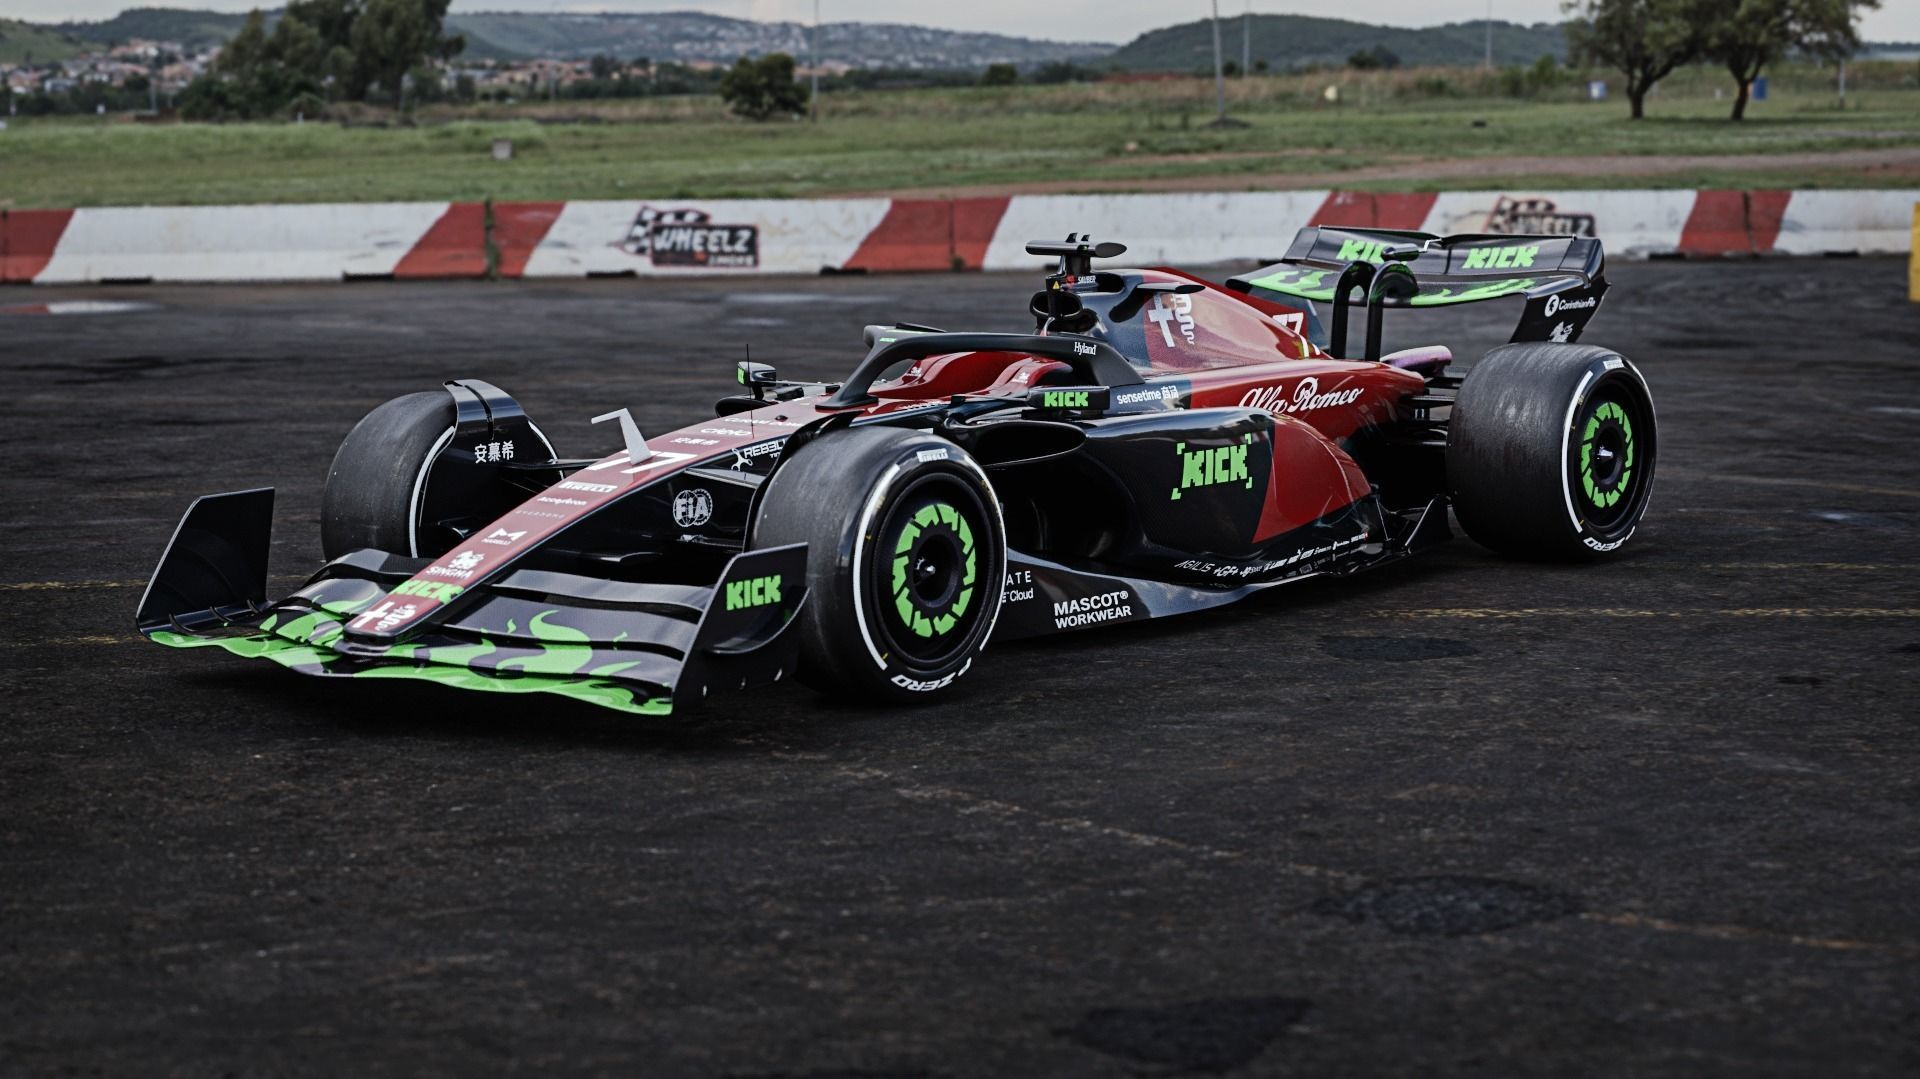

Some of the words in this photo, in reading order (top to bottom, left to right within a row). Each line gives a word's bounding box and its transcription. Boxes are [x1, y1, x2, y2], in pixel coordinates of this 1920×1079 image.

[654, 227, 752, 253] WHEELZ
[1462, 245, 1539, 268] KICK
[1074, 341, 1097, 355] Hyland
[1044, 391, 1089, 407] KICK
[1117, 390, 1161, 404] sensetime
[1238, 385, 1288, 413] Alfa
[1287, 376, 1365, 413] Romeo
[474, 440, 514, 464] 安慕希
[1181, 444, 1249, 488] KICK
[558, 481, 618, 493] PIRELLI
[426, 566, 475, 580] SINGHA
[726, 574, 782, 611] KICK
[1010, 588, 1034, 602] Cloud
[1055, 605, 1132, 629] WORKWEAR
[890, 672, 957, 692] ZERO
